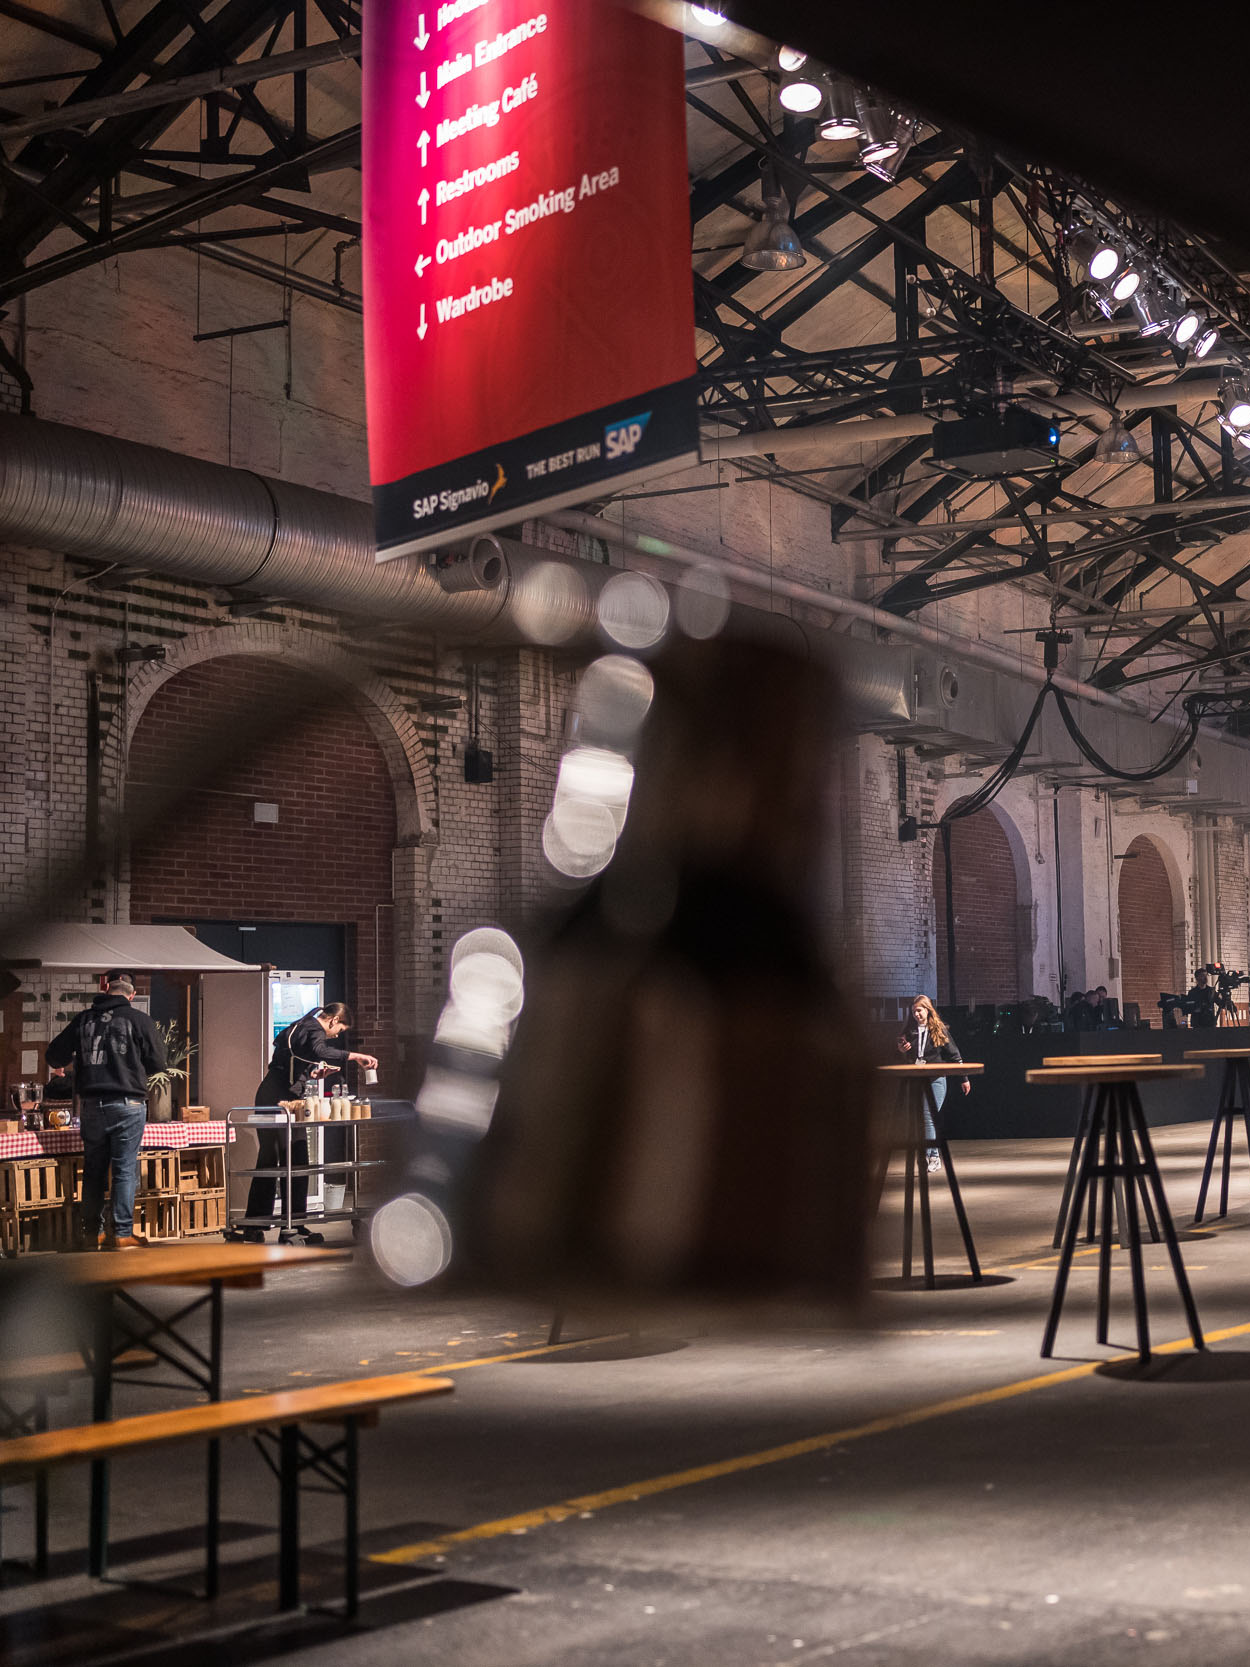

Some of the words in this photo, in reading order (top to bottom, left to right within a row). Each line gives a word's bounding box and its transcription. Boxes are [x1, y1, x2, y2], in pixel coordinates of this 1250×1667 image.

[437, 53, 472, 90] Main
[475, 13, 547, 68] Entrance
[437, 100, 500, 148] Meeting
[501, 73, 538, 113] Café
[437, 151, 519, 206] Restrooms
[436, 219, 501, 264] Outdoor
[505, 186, 576, 235] Smoking
[579, 166, 620, 200] Area
[436, 277, 513, 324] Wardrobe
[526, 460, 546, 480] THE
[549, 451, 574, 473] BEST
[576, 442, 601, 467] RUN
[605, 423, 642, 460] SAP
[413, 494, 438, 520] SAP
[440, 479, 489, 512] Signavio
